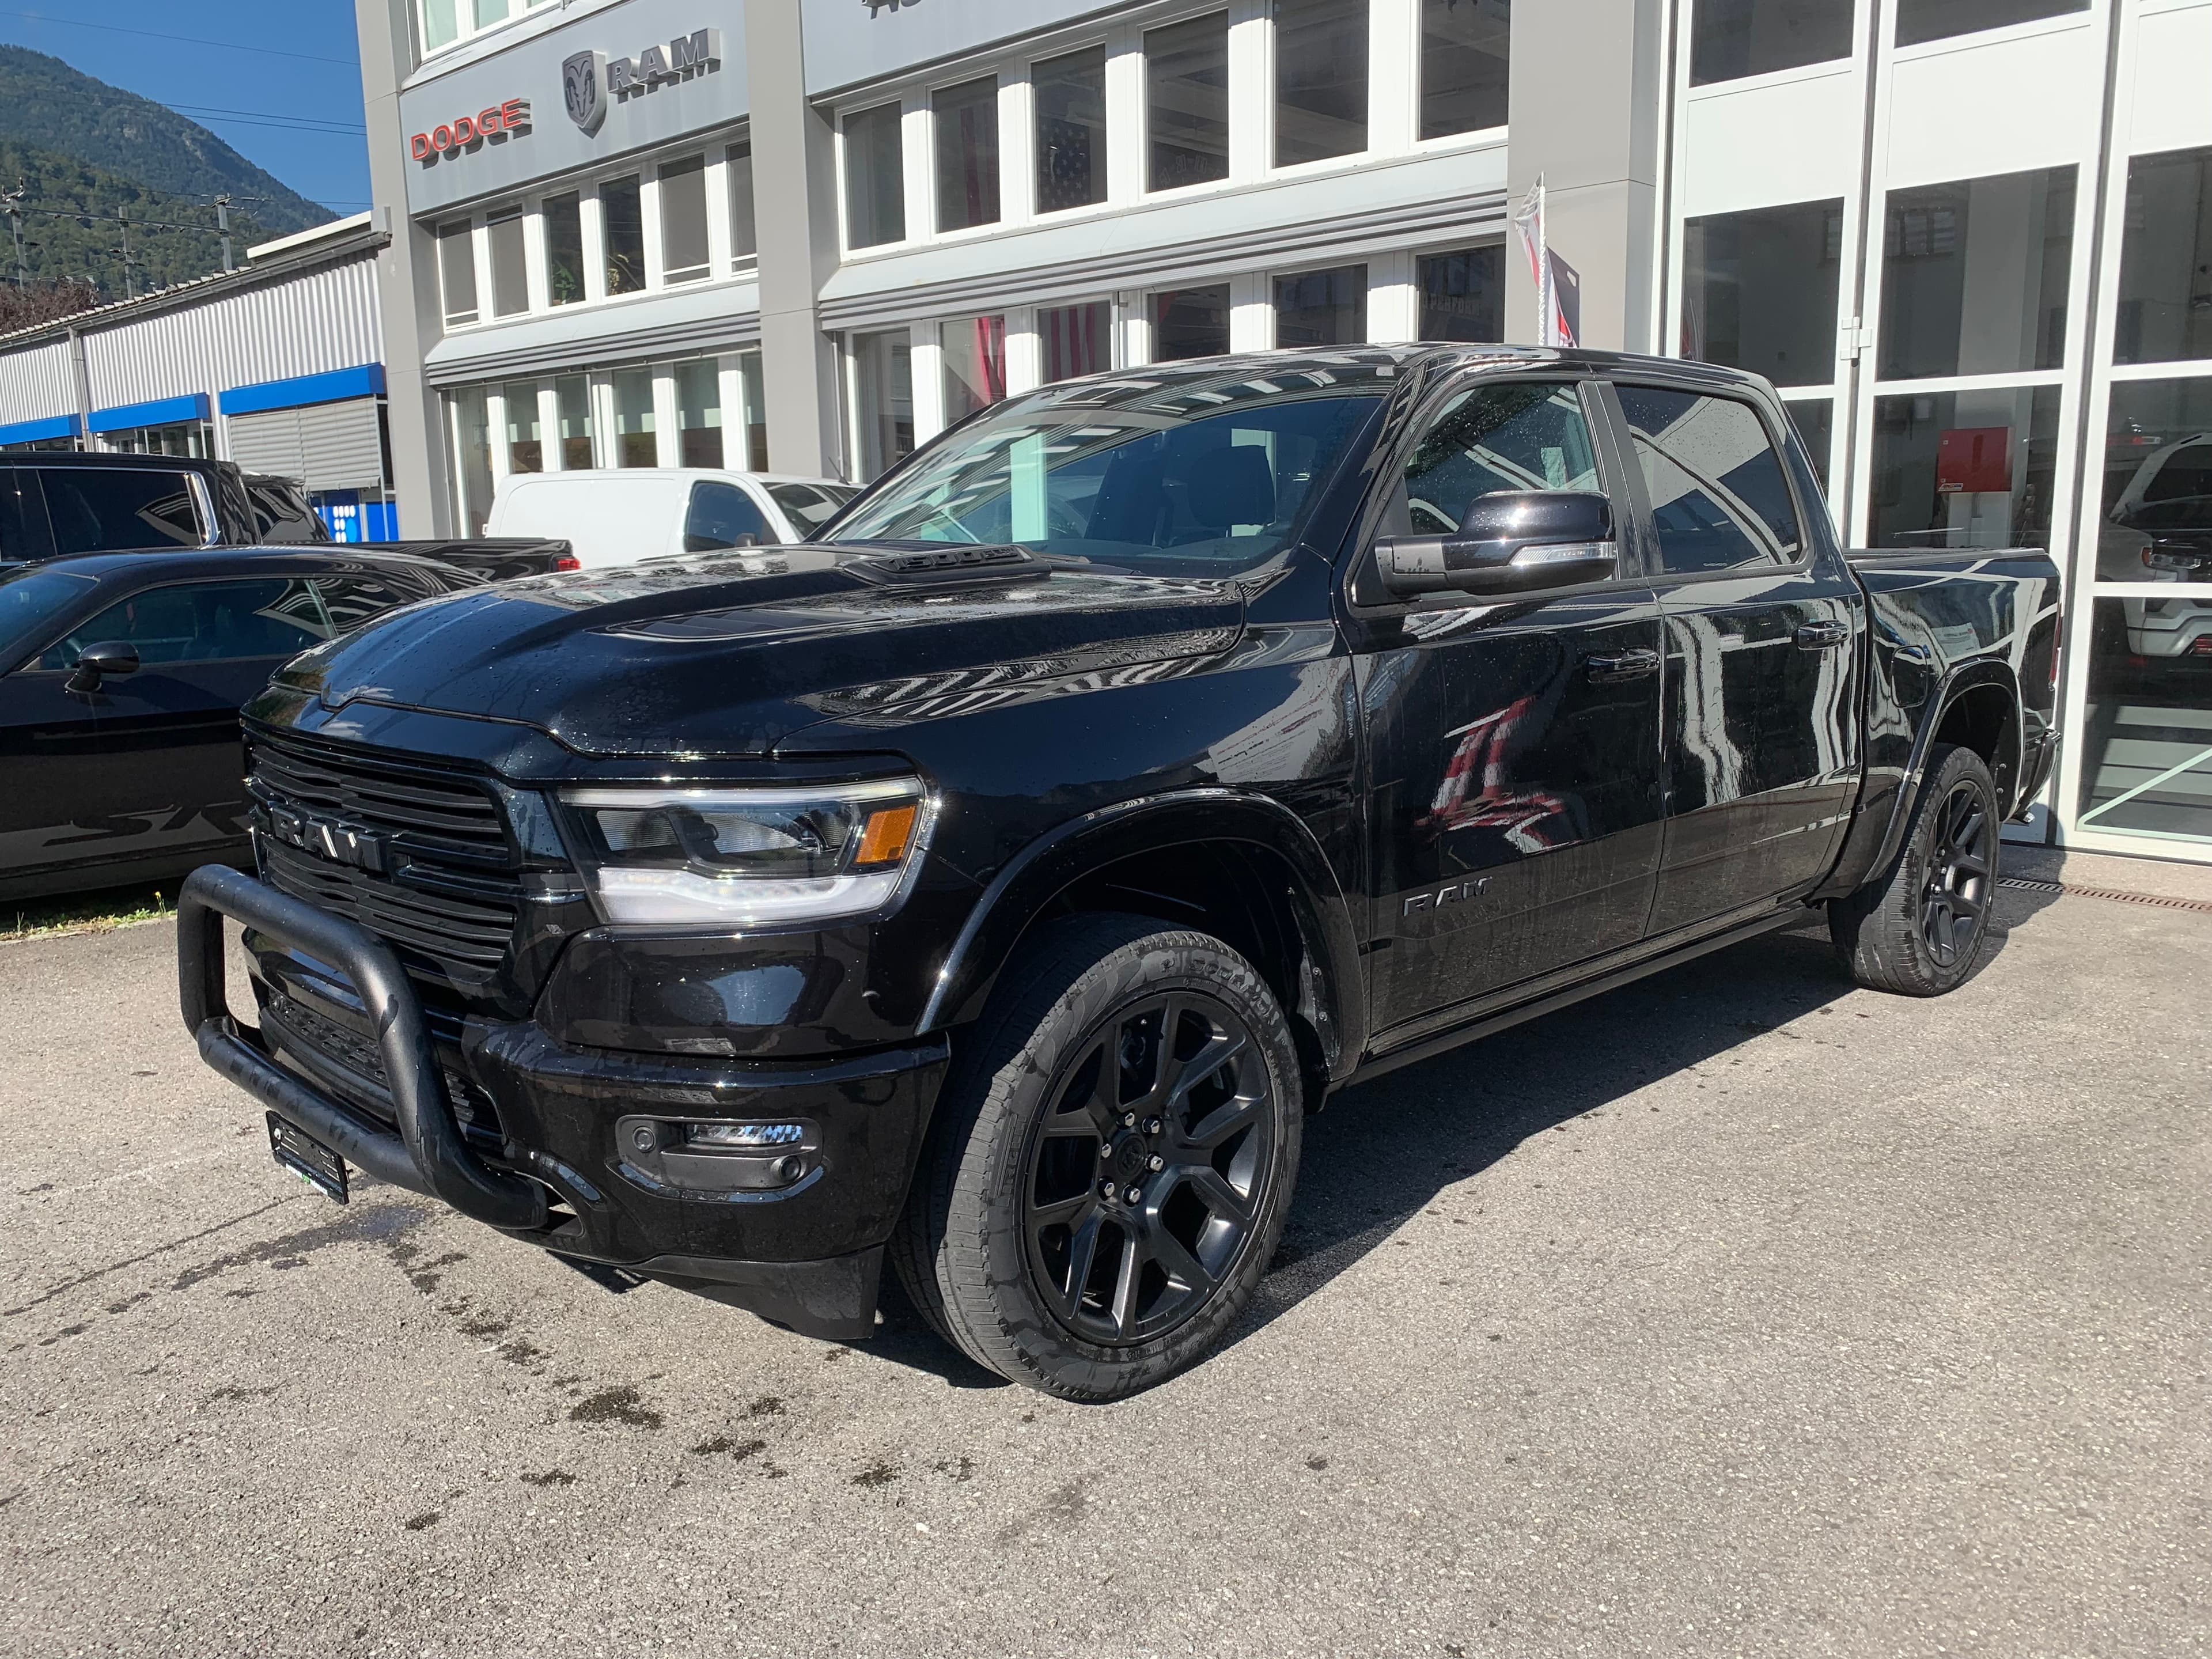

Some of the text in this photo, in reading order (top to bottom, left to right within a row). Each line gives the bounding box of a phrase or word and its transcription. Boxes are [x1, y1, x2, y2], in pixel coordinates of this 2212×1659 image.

[606, 28, 718, 93] RAM
[411, 97, 525, 160] DODGE
[889, 551, 982, 571] 1500
[272, 806, 382, 872] RAM
[1403, 876, 1493, 917] RAM
